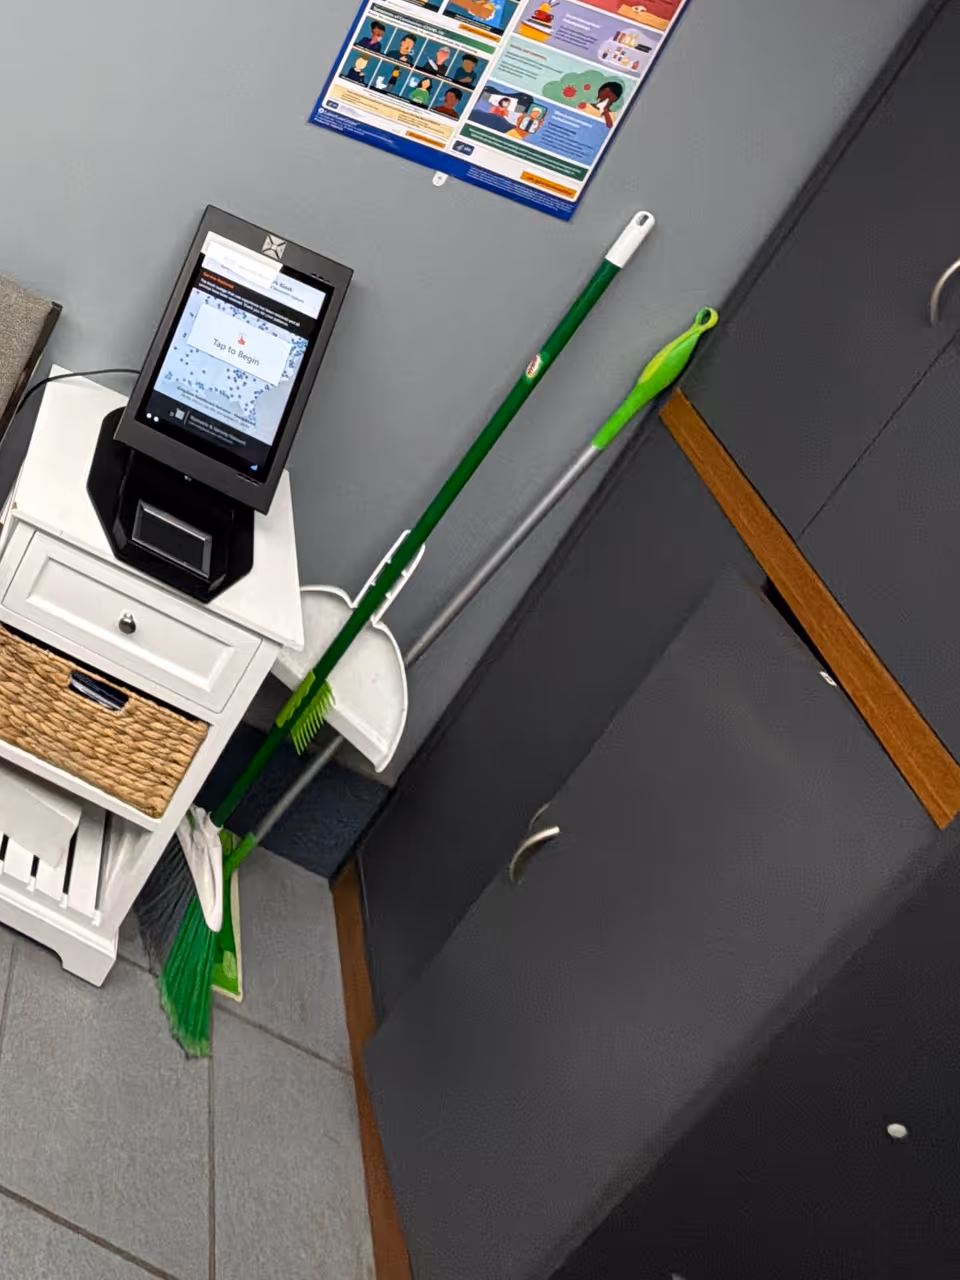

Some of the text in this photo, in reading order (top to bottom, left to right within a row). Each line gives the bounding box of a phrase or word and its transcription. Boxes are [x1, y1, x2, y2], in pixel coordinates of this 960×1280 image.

[213, 338, 260, 366] Tap to Begin
